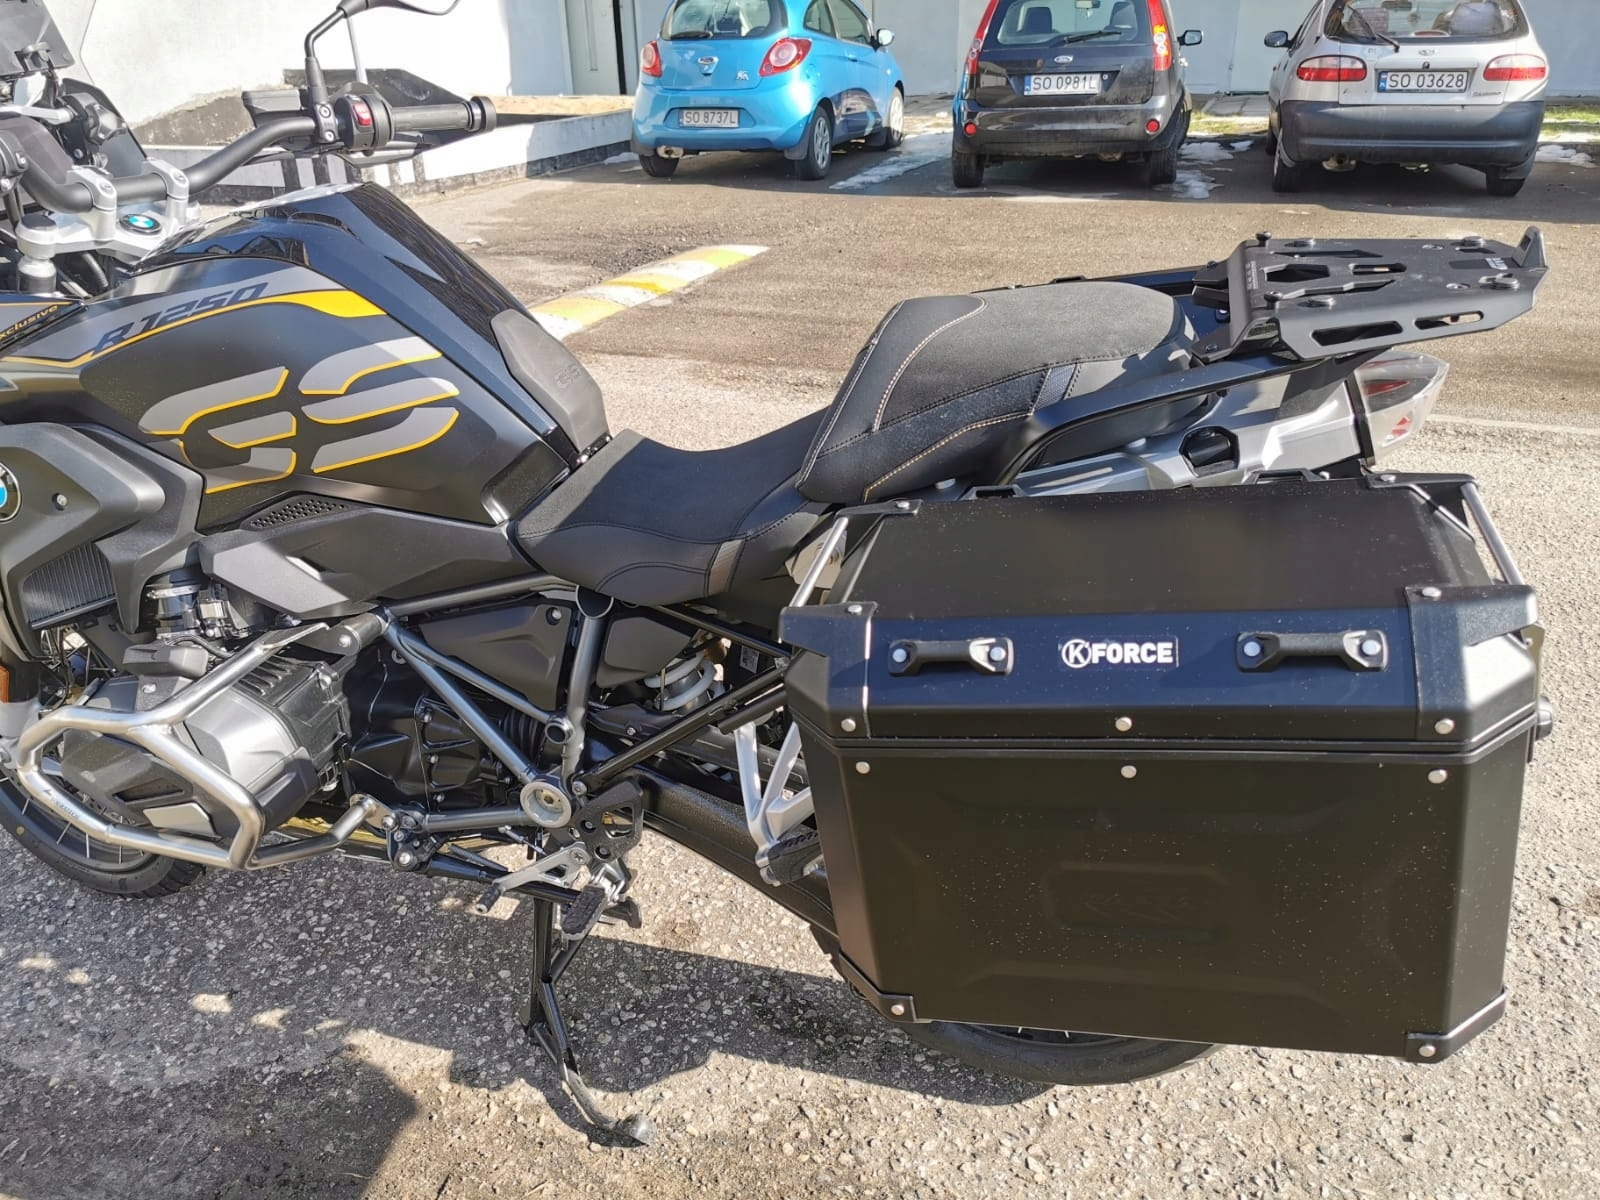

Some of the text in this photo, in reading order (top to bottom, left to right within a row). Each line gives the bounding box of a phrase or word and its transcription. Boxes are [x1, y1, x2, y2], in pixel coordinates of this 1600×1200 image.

[1033, 75, 1096, 90] SO 0981L
[1389, 73, 1464, 88] SO 03628
[685, 111, 736, 124] SO 8737L
[140, 281, 269, 333] 1250
[0, 305, 58, 340] xclusive
[138, 336, 460, 494] GS
